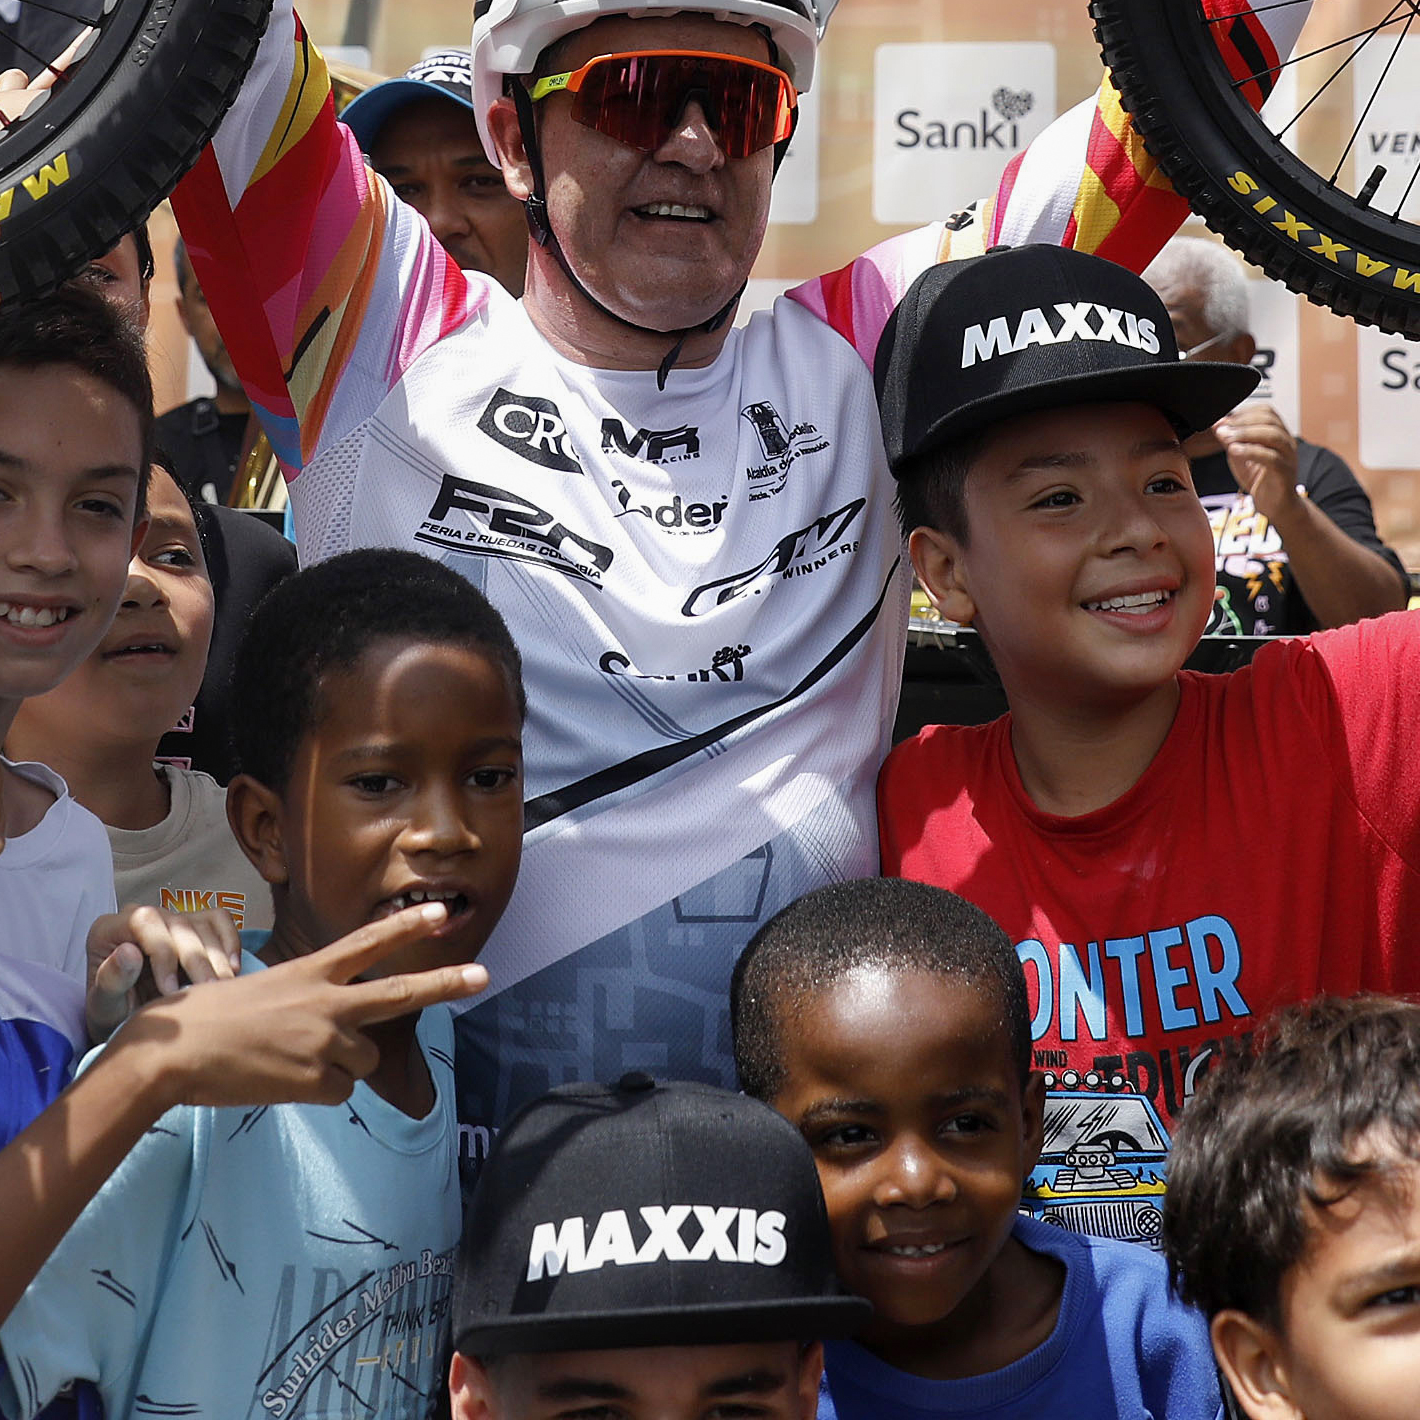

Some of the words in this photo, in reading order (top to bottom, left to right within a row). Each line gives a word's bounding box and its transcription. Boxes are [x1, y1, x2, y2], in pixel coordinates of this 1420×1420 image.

[895, 110, 1021, 151] Sanki
[961, 302, 1161, 369] MAXXIS
[419, 521, 463, 540] FERIA
[464, 532, 476, 542] 2
[476, 534, 537, 553] RUEDAS
[783, 540, 861, 580] WINNERS
[159, 888, 246, 914] NIKE
[1014, 914, 1253, 1042] ONTER
[526, 1204, 787, 1283] MAXXIS
[358, 1260, 416, 1317] Malibu
